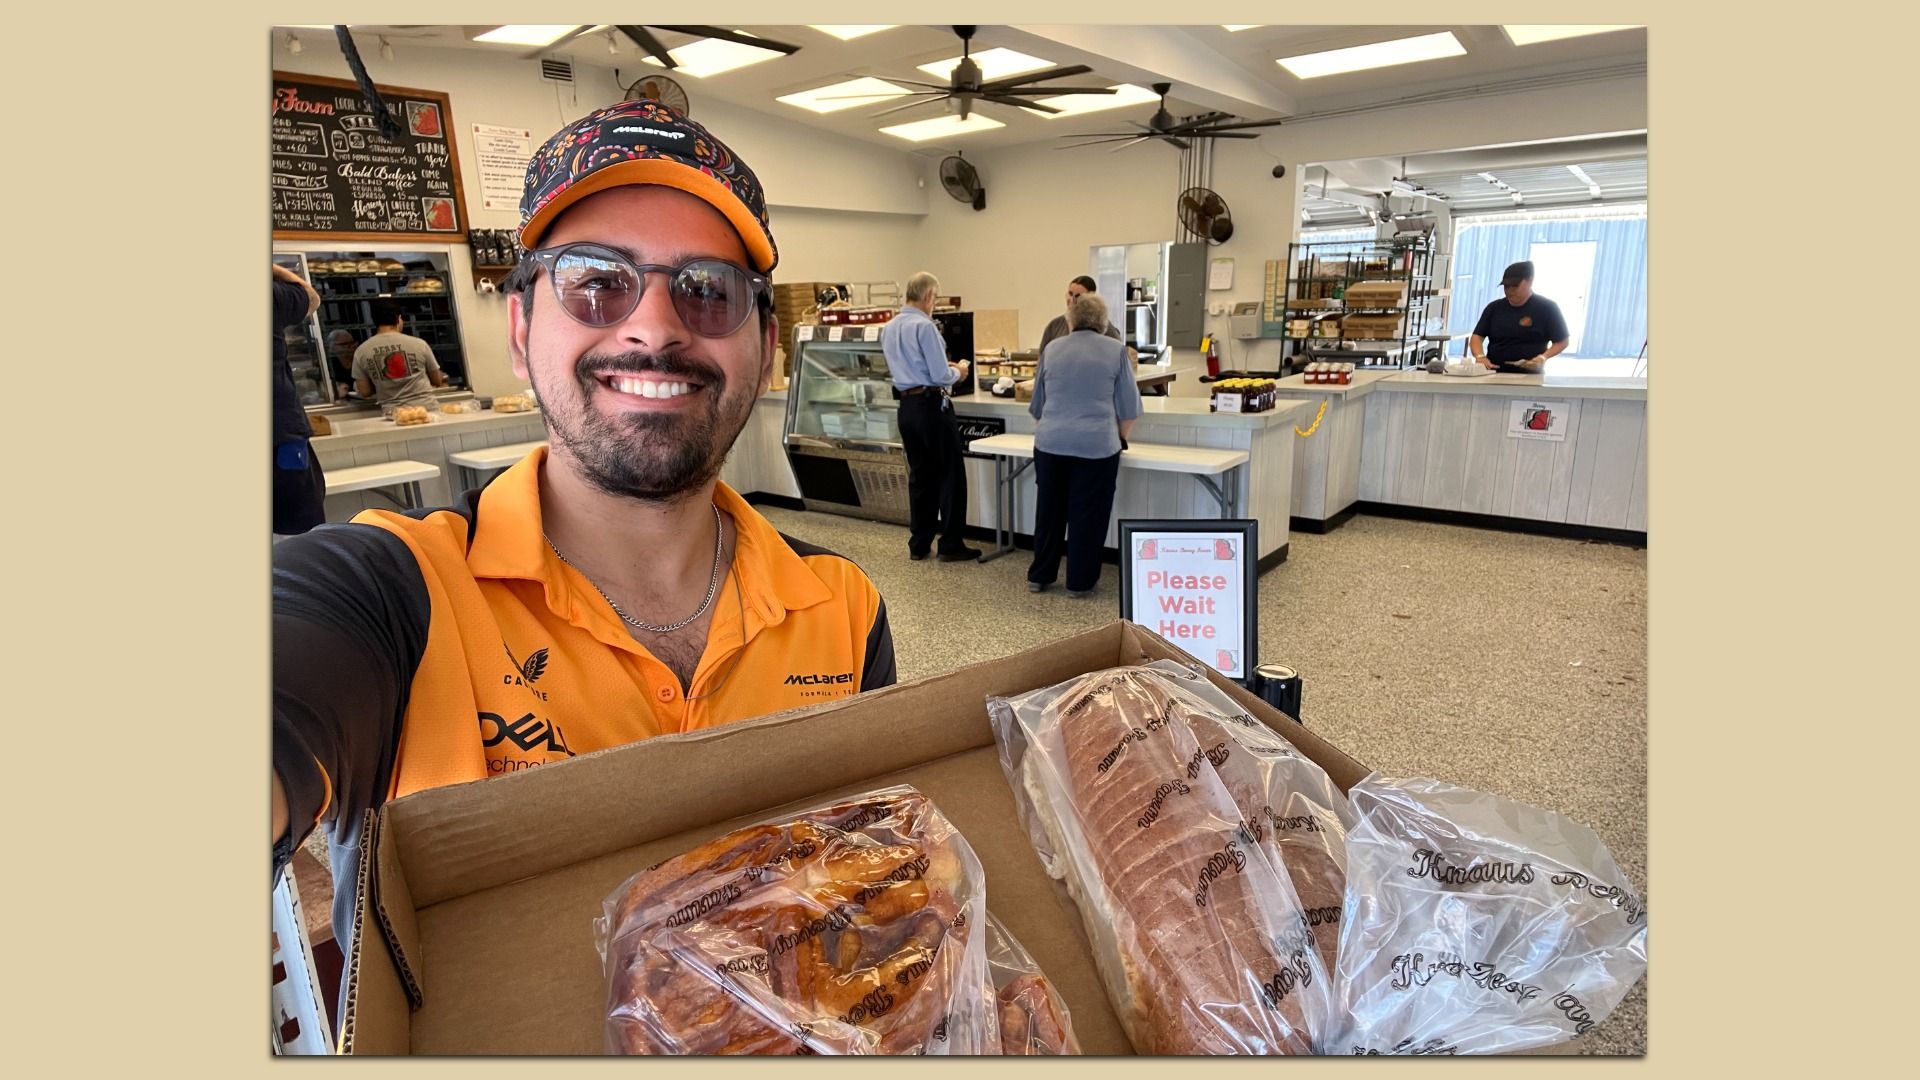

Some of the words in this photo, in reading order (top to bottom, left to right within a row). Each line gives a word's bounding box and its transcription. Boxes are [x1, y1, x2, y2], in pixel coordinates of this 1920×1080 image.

[276, 88, 336, 116] Farm
[613, 126, 685, 140] McLaren
[415, 142, 447, 156] THANK
[337, 162, 374, 178] Bald
[373, 165, 418, 182] Baker's
[427, 180, 449, 190] AGAIN
[1147, 570, 1227, 590] Please
[1158, 595, 1216, 615] Wait
[1159, 620, 1217, 639] Here
[1137, 778, 1191, 829] Farm
[853, 852, 931, 906] Knaus
[1195, 840, 1248, 908] Farm
[1407, 848, 1536, 886] Knaus
[665, 880, 742, 929] Farm
[771, 903, 853, 956] Berry
